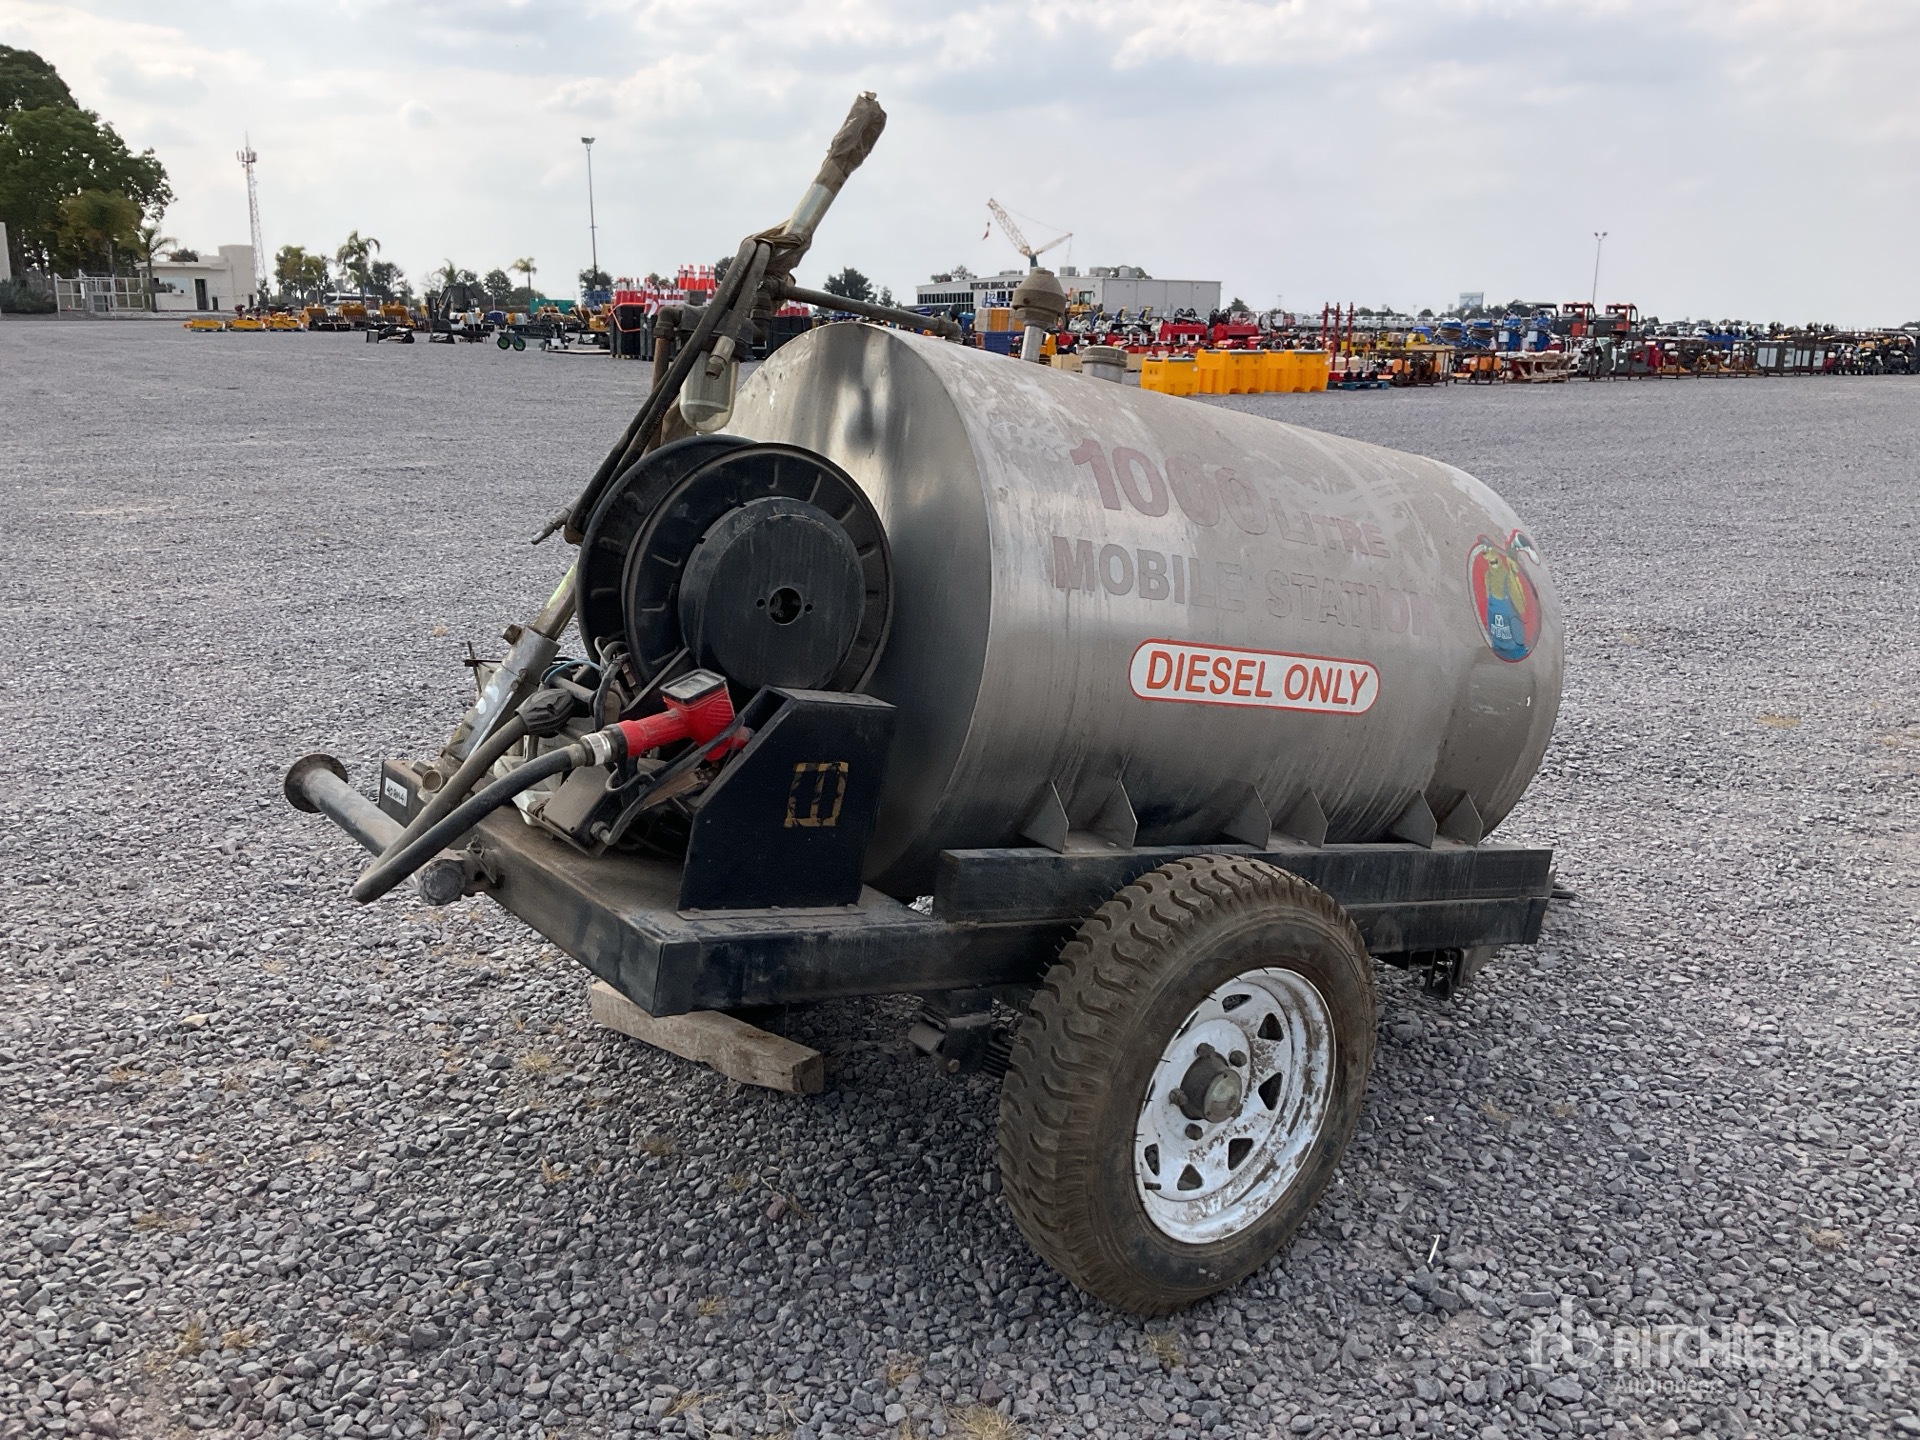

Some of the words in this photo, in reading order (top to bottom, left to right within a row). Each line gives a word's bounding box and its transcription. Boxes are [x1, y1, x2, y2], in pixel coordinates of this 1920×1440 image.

[1070, 438, 1270, 536] 1000
[1269, 496, 1391, 559] LITRE
[1052, 535, 1246, 614] MOBILE
[1146, 650, 1273, 698] DIESEL
[1284, 663, 1369, 706] ONLY
